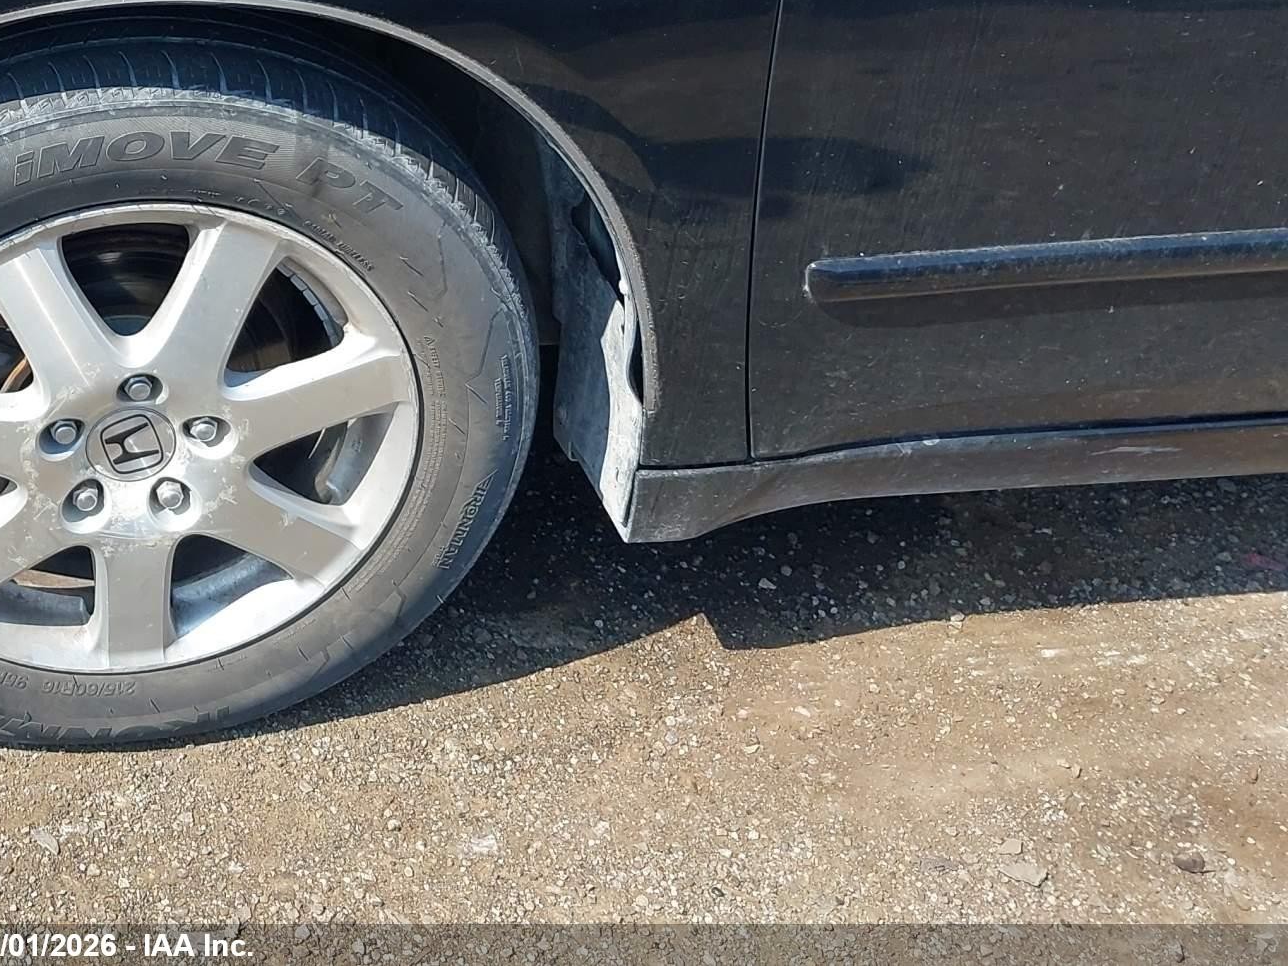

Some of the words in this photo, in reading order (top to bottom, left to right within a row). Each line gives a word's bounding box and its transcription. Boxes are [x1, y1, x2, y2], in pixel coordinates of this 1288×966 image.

[13, 131, 280, 187] iMOVE
[295, 156, 404, 215] PT
[435, 480, 491, 570] IRONMAN
[41, 680, 136, 697] 215/60R16
